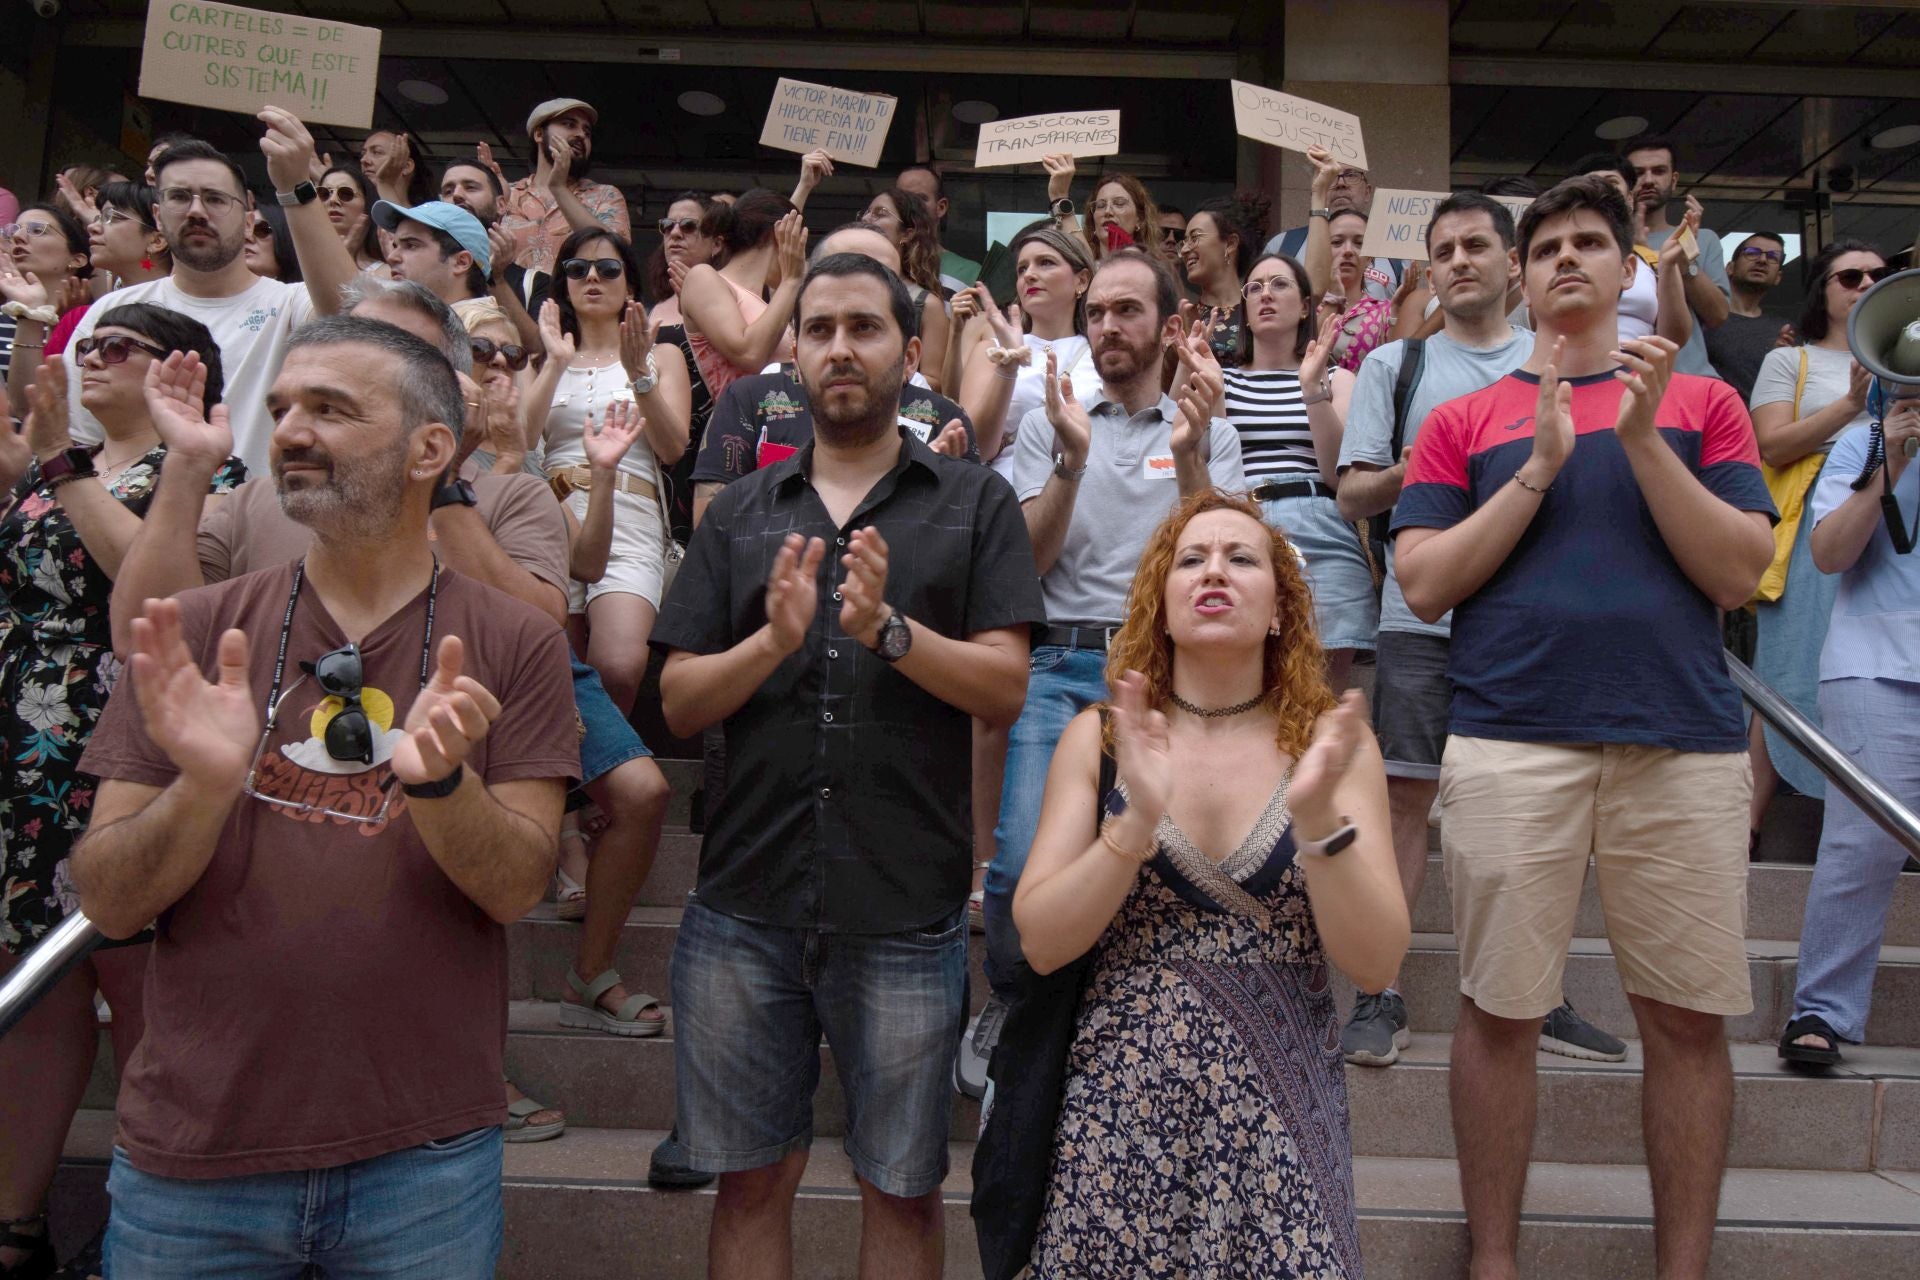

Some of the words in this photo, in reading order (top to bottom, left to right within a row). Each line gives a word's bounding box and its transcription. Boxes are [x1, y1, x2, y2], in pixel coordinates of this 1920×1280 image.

[169, 3, 284, 36] CARTELES
[317, 26, 345, 42] DE
[163, 30, 247, 59] CUTRES
[257, 44, 302, 67] QUE
[311, 53, 361, 74] ESTE
[784, 84, 828, 104] VICTOR
[875, 100, 889, 117] TU
[783, 124, 820, 145] TIENE
[855, 118, 876, 132] NO
[1260, 117, 1358, 160] JUSTAS
[1386, 223, 1411, 241] NO
